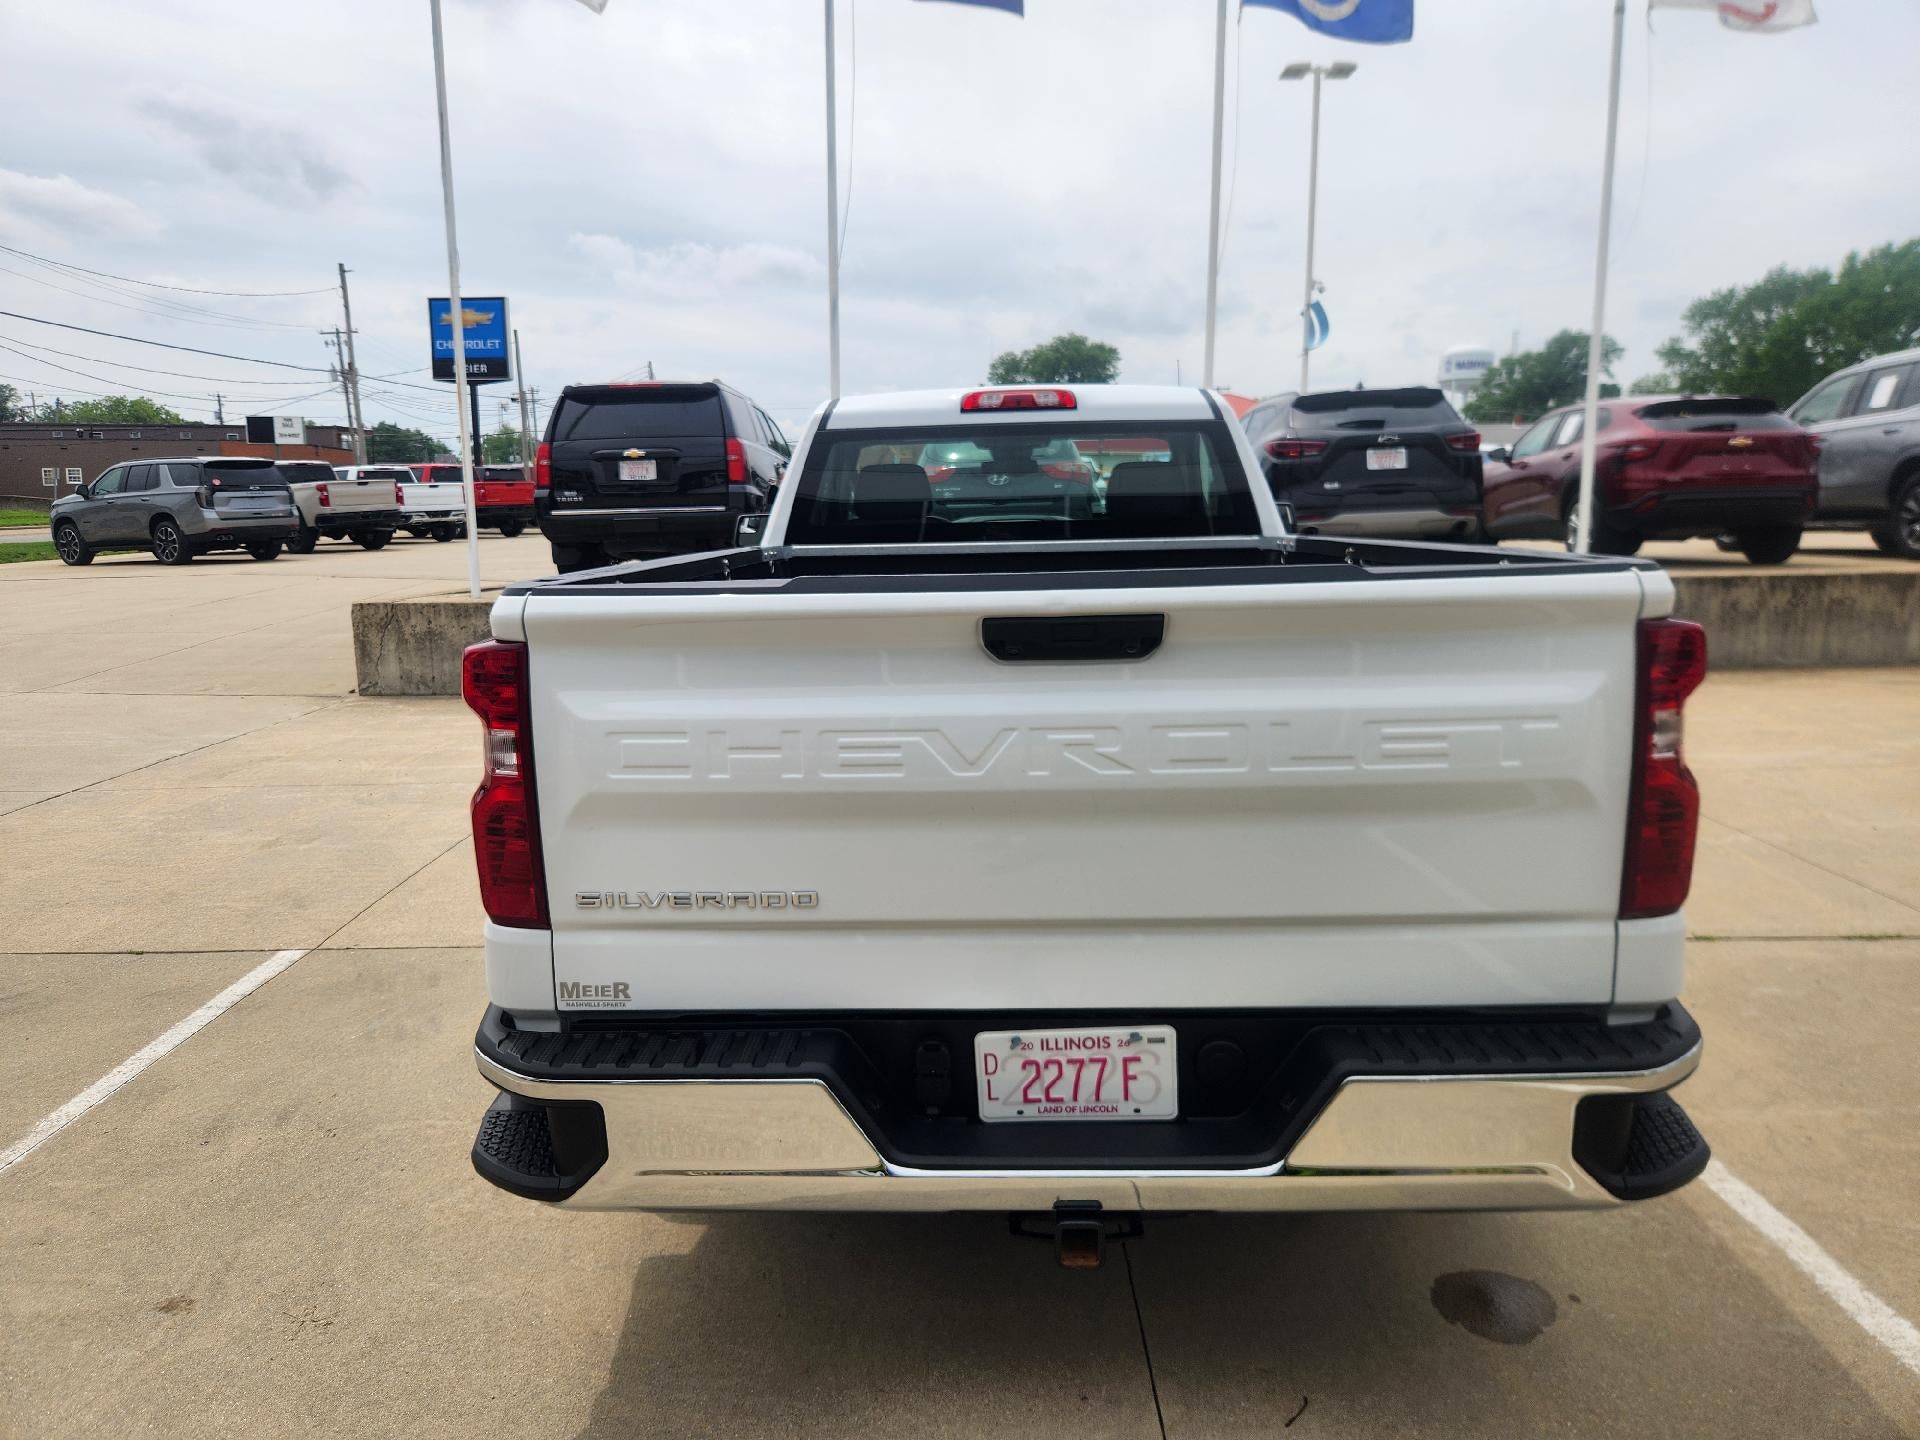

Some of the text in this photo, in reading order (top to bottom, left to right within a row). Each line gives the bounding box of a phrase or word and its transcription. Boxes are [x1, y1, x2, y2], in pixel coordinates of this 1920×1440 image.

[604, 715, 1561, 779] CHEVROLET
[575, 890, 819, 909] SILVERADO
[1020, 1041, 1034, 1050] 20
[1040, 1036, 1112, 1051] ILLINOIS
[1021, 1055, 1142, 1104] 2277 F
[1037, 1104, 1118, 1114] LAND OF LINCOLN
